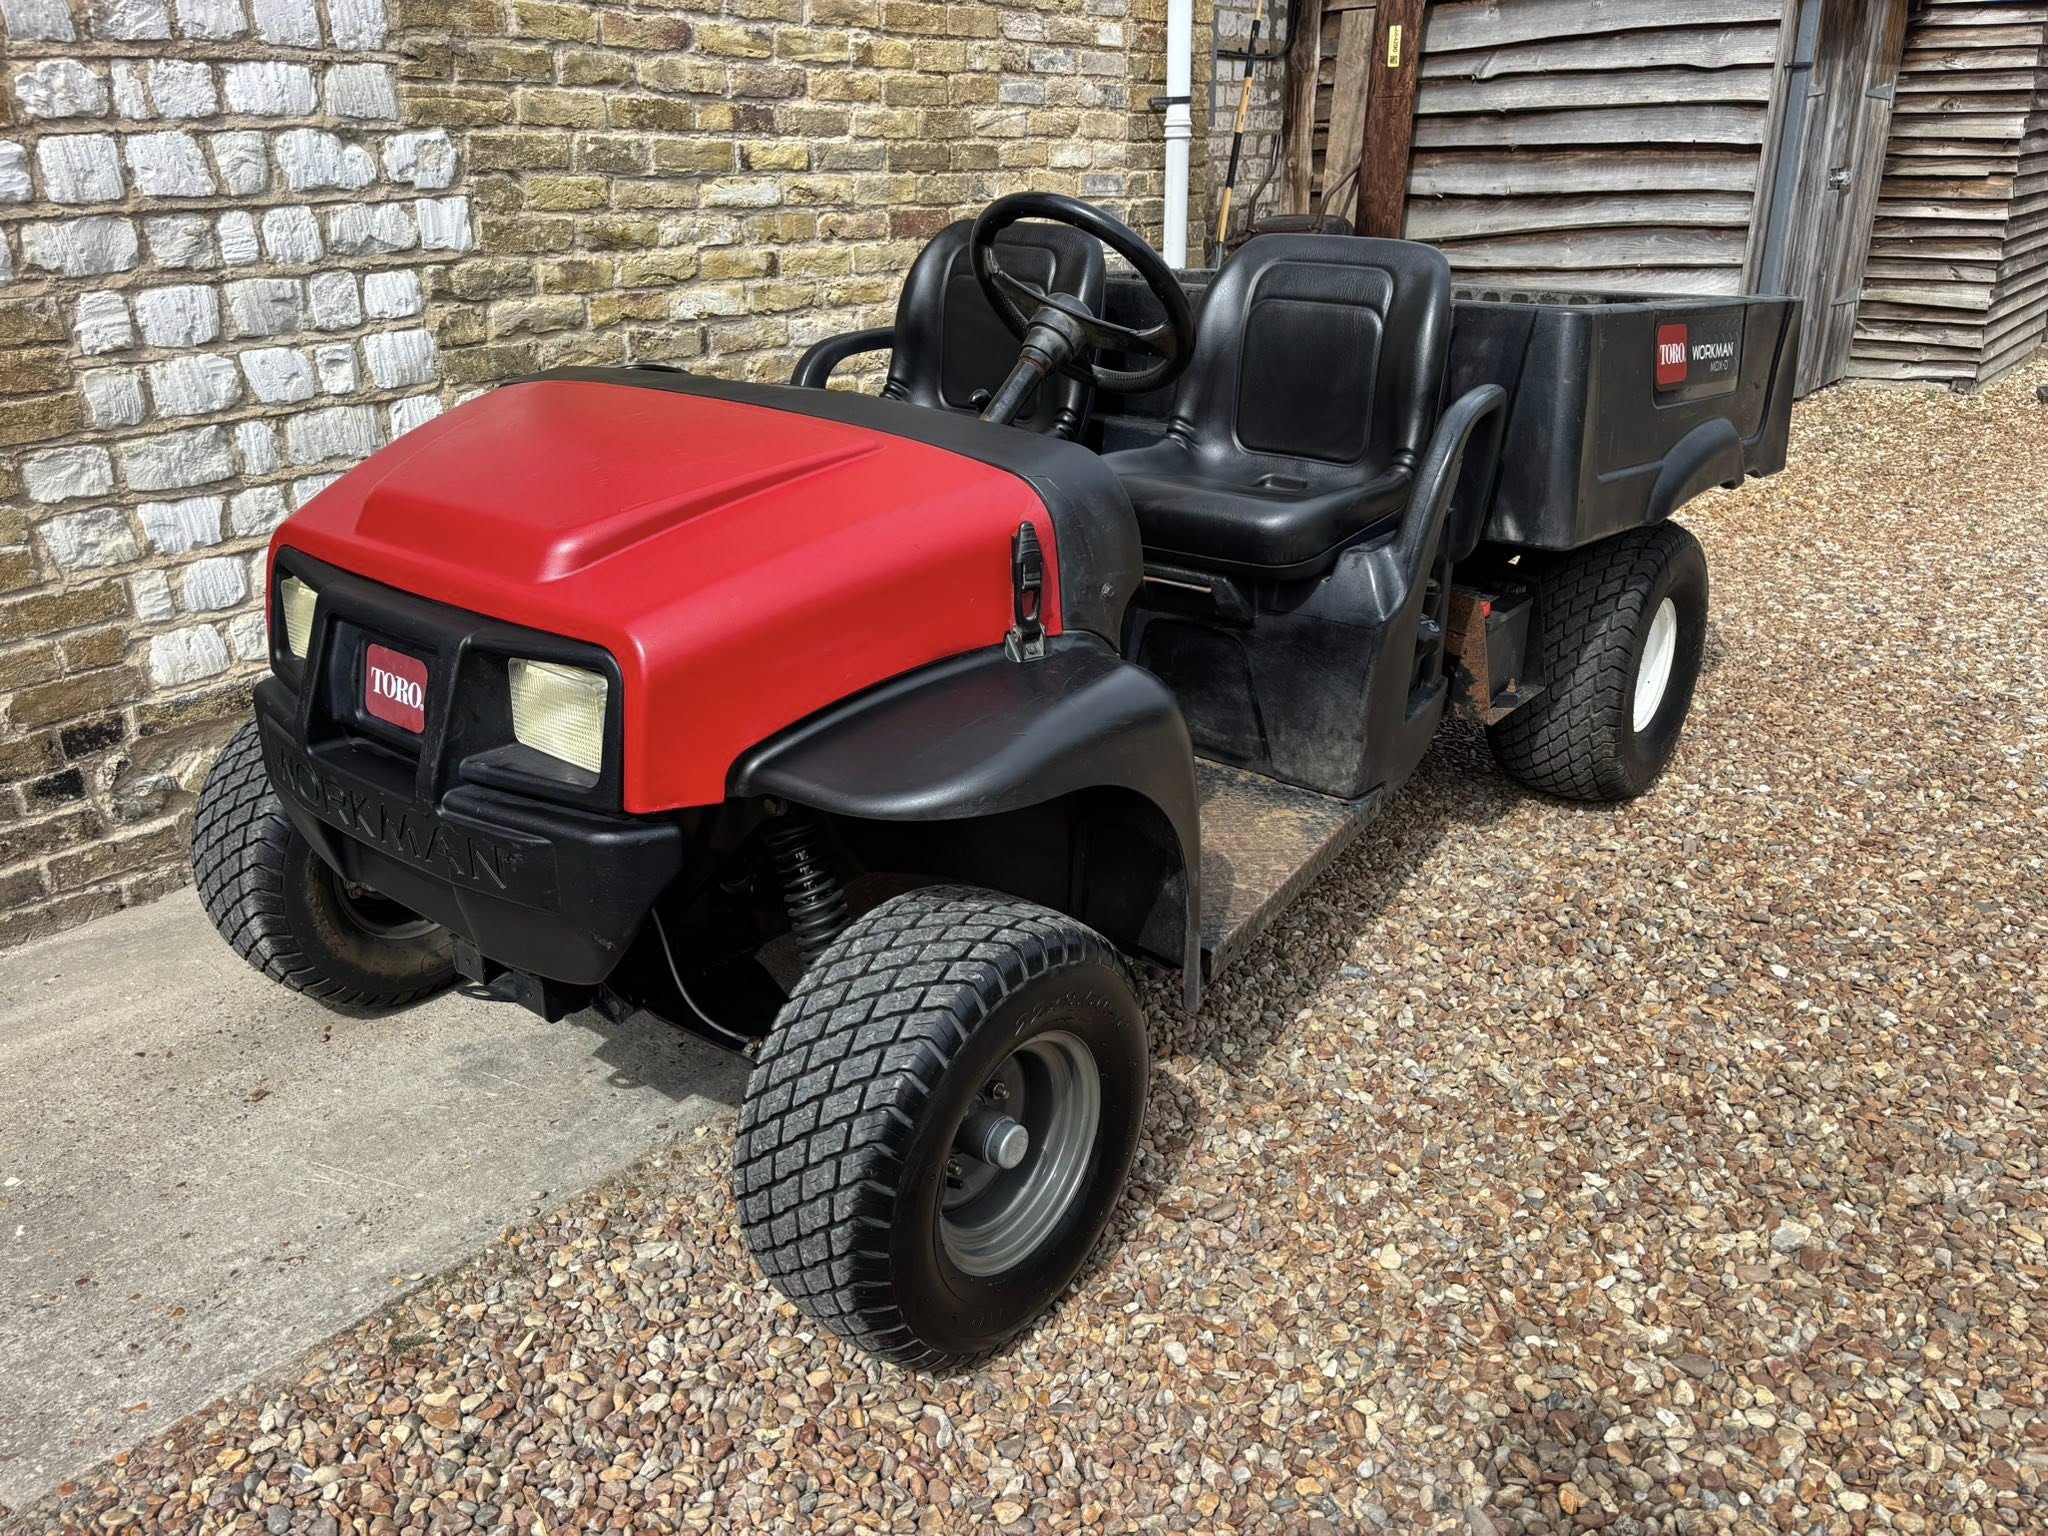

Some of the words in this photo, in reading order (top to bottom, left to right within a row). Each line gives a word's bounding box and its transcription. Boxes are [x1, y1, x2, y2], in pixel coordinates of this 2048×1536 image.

[1660, 342, 1685, 365] TORO
[1692, 342, 1734, 360] WORKMAN
[371, 667, 422, 709] TORO
[278, 744, 507, 890] WORKMAN
